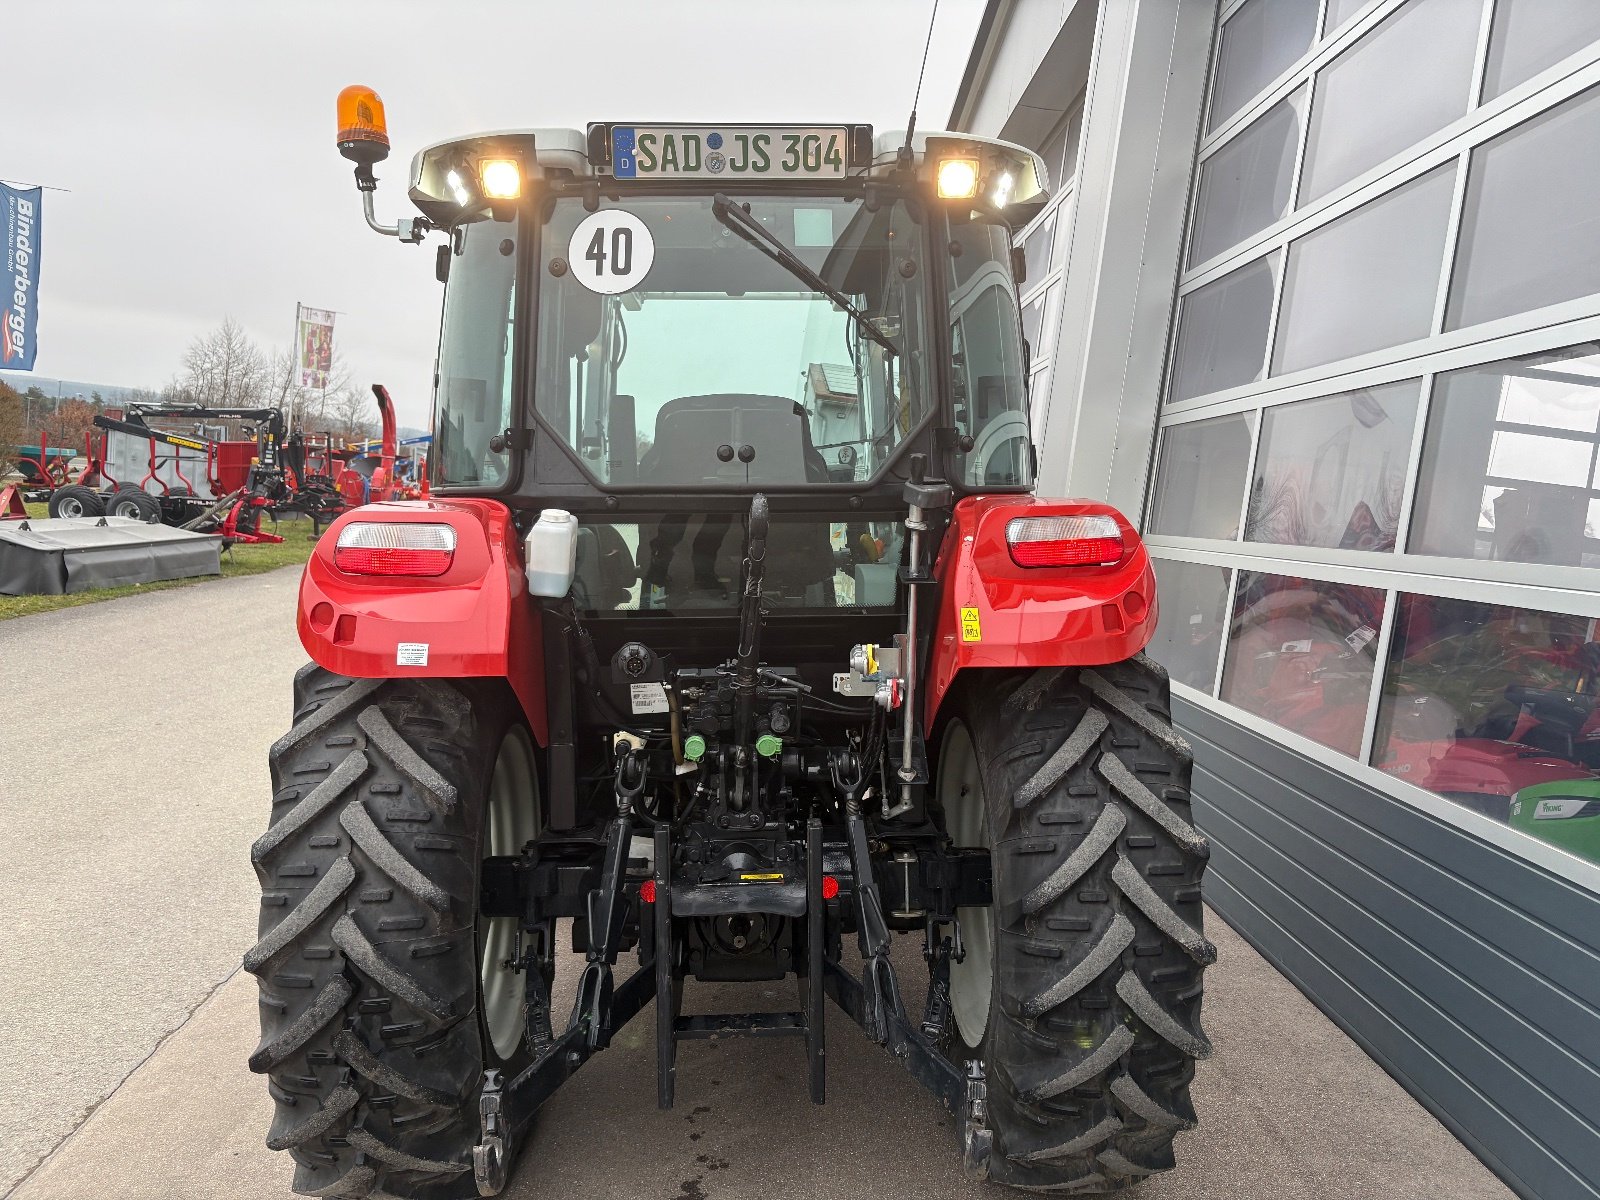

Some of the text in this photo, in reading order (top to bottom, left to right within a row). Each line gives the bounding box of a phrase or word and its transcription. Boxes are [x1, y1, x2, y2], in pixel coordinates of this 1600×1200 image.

[621, 158, 629, 169] D
[637, 133, 843, 173] SAD JS 304
[585, 227, 633, 276] 40
[9, 198, 33, 359] Binderberger
